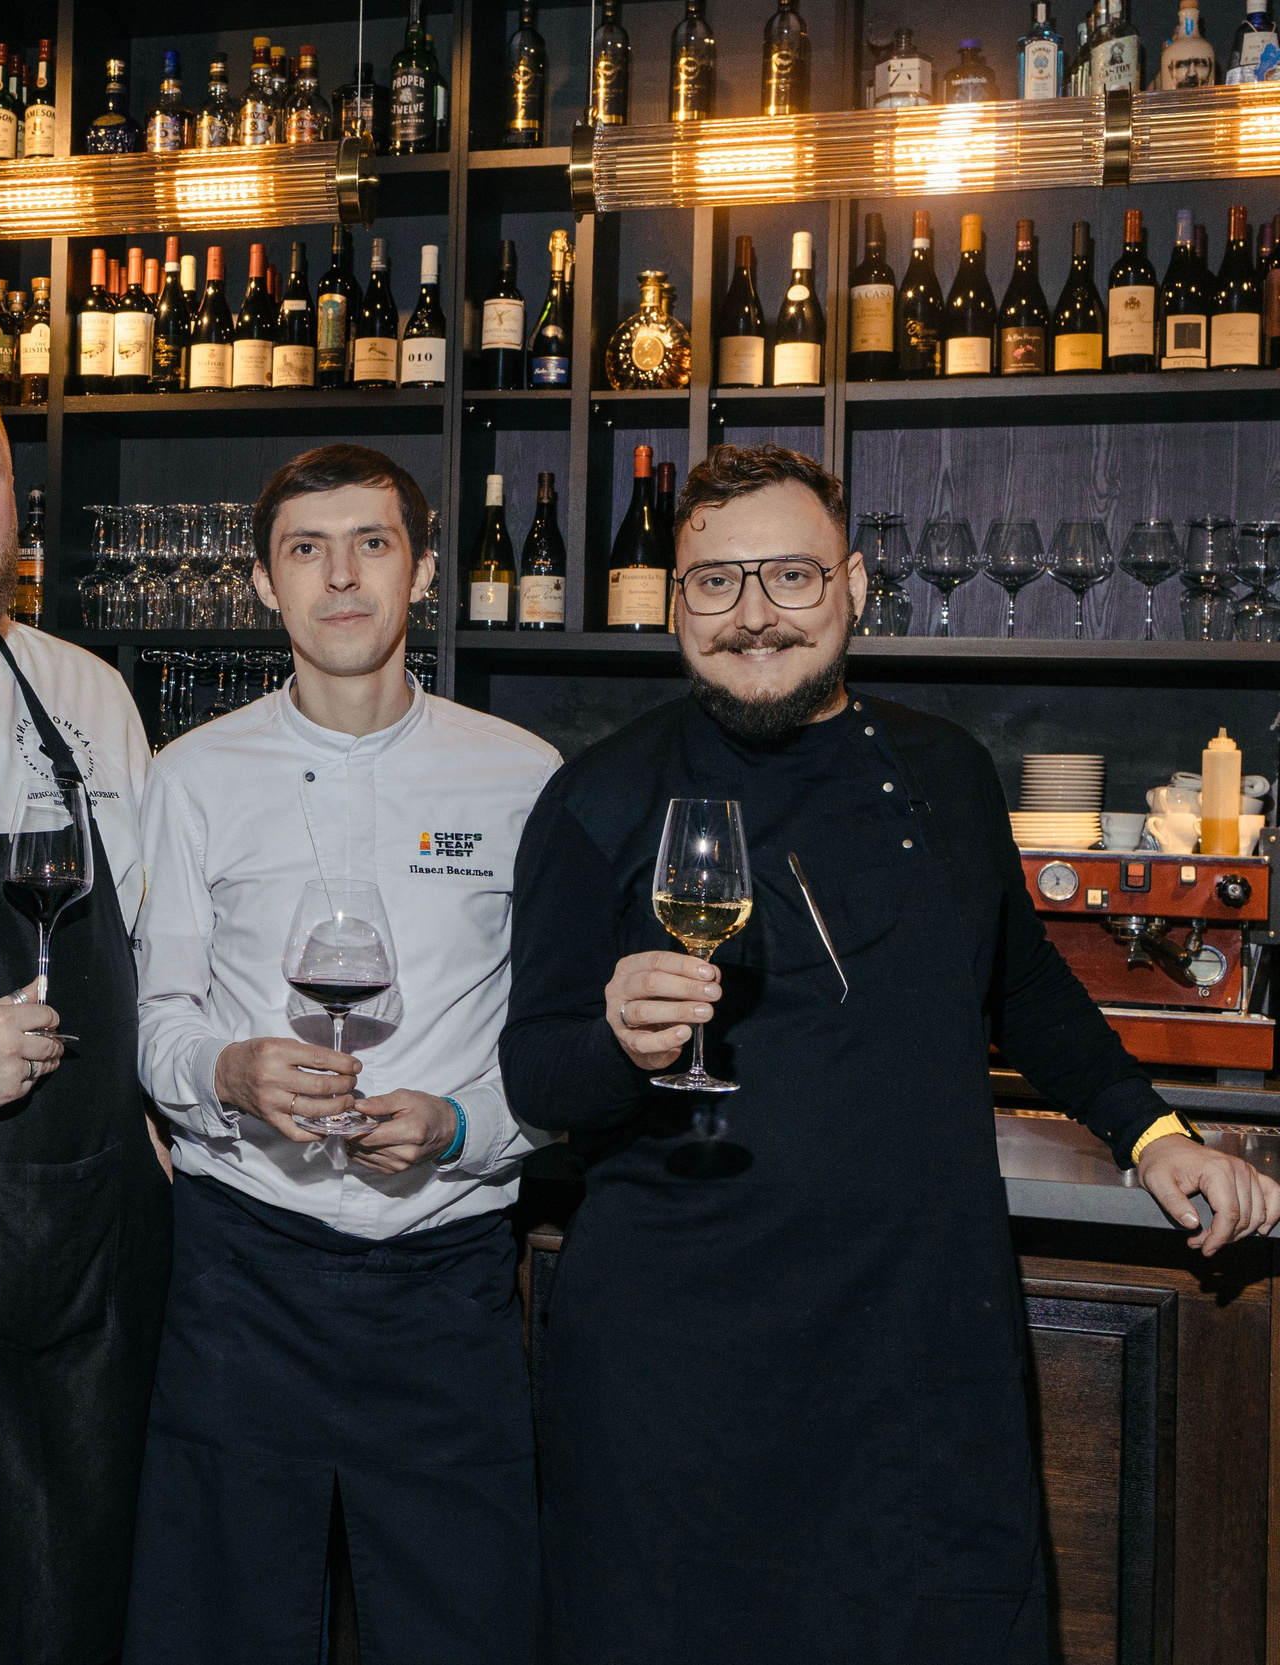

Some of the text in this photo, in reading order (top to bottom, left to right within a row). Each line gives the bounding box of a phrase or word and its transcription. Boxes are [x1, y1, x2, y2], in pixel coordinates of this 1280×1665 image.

[392, 75, 425, 90] PROPER
[393, 102, 425, 114] TWELVE
[408, 352, 433, 362] 010
[433, 832, 483, 841] CHEFS
[434, 840, 474, 849] TEAM
[435, 848, 473, 857] FEST
[409, 864, 494, 877] Павел Васильев
